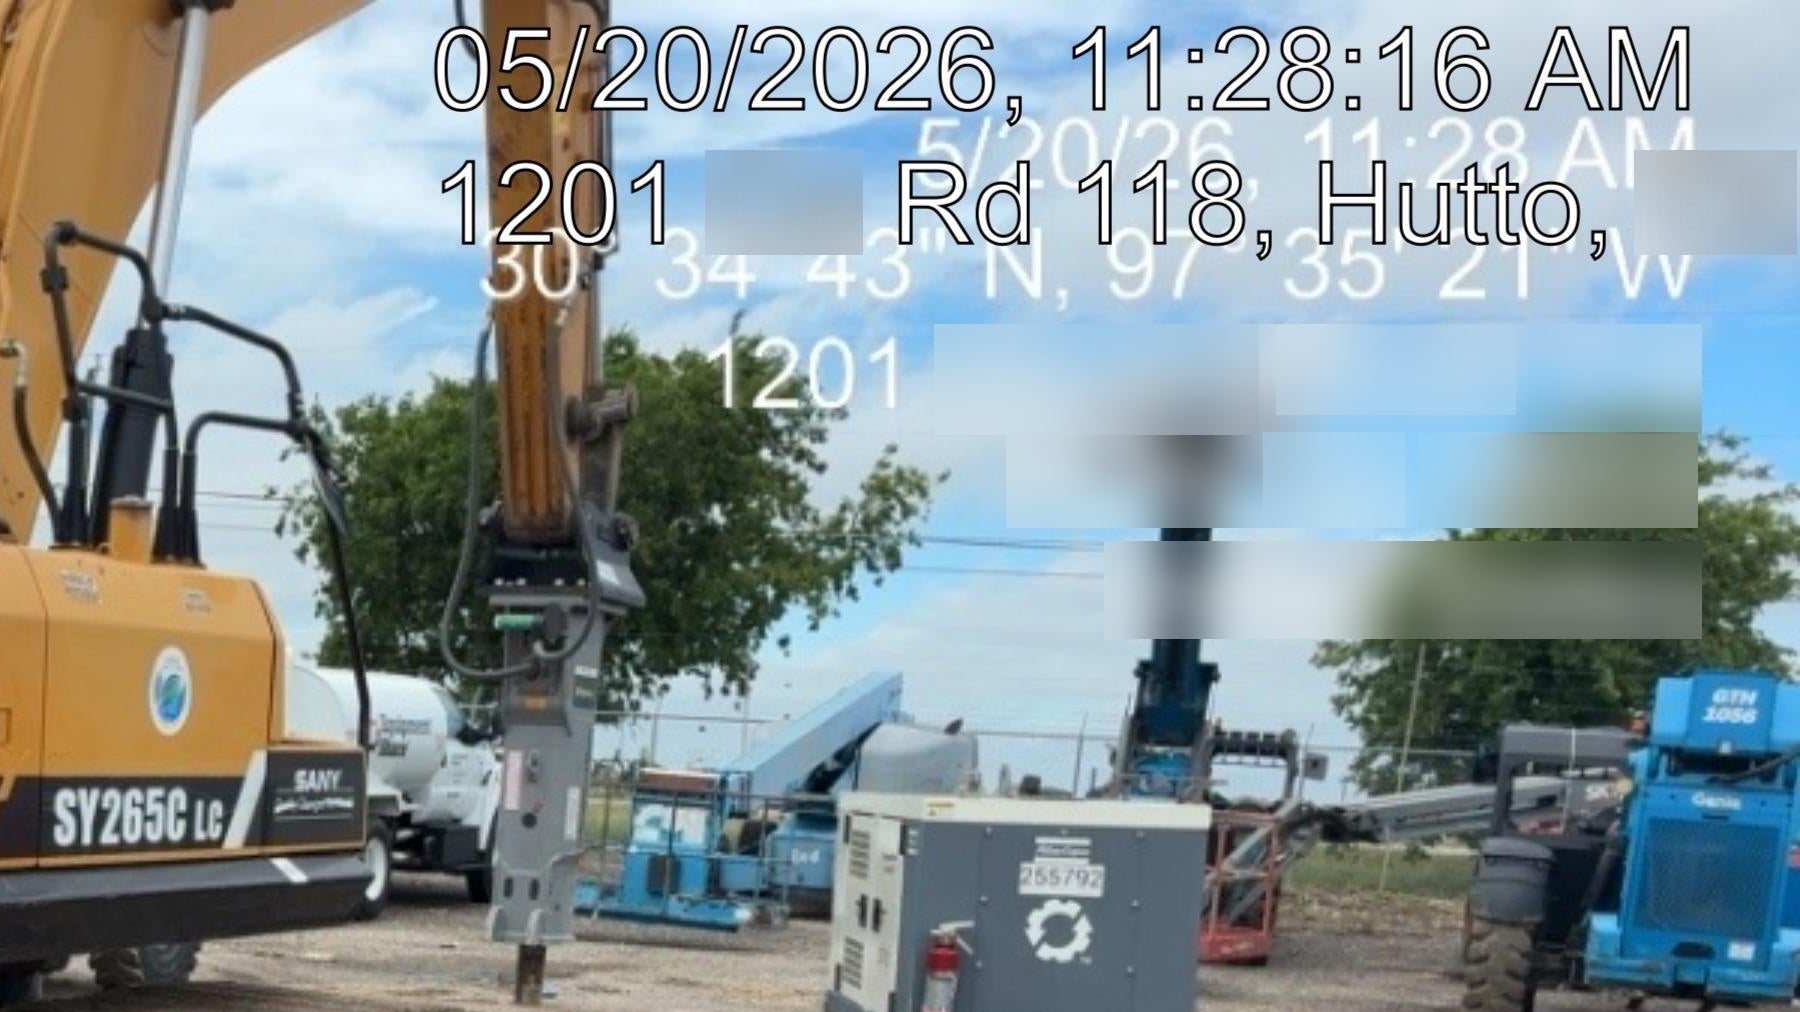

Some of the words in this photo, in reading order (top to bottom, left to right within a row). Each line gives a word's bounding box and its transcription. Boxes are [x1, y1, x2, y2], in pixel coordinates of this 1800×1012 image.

[294, 768, 343, 792] SANY
[53, 786, 188, 848] SY265C
[194, 799, 224, 841] LC
